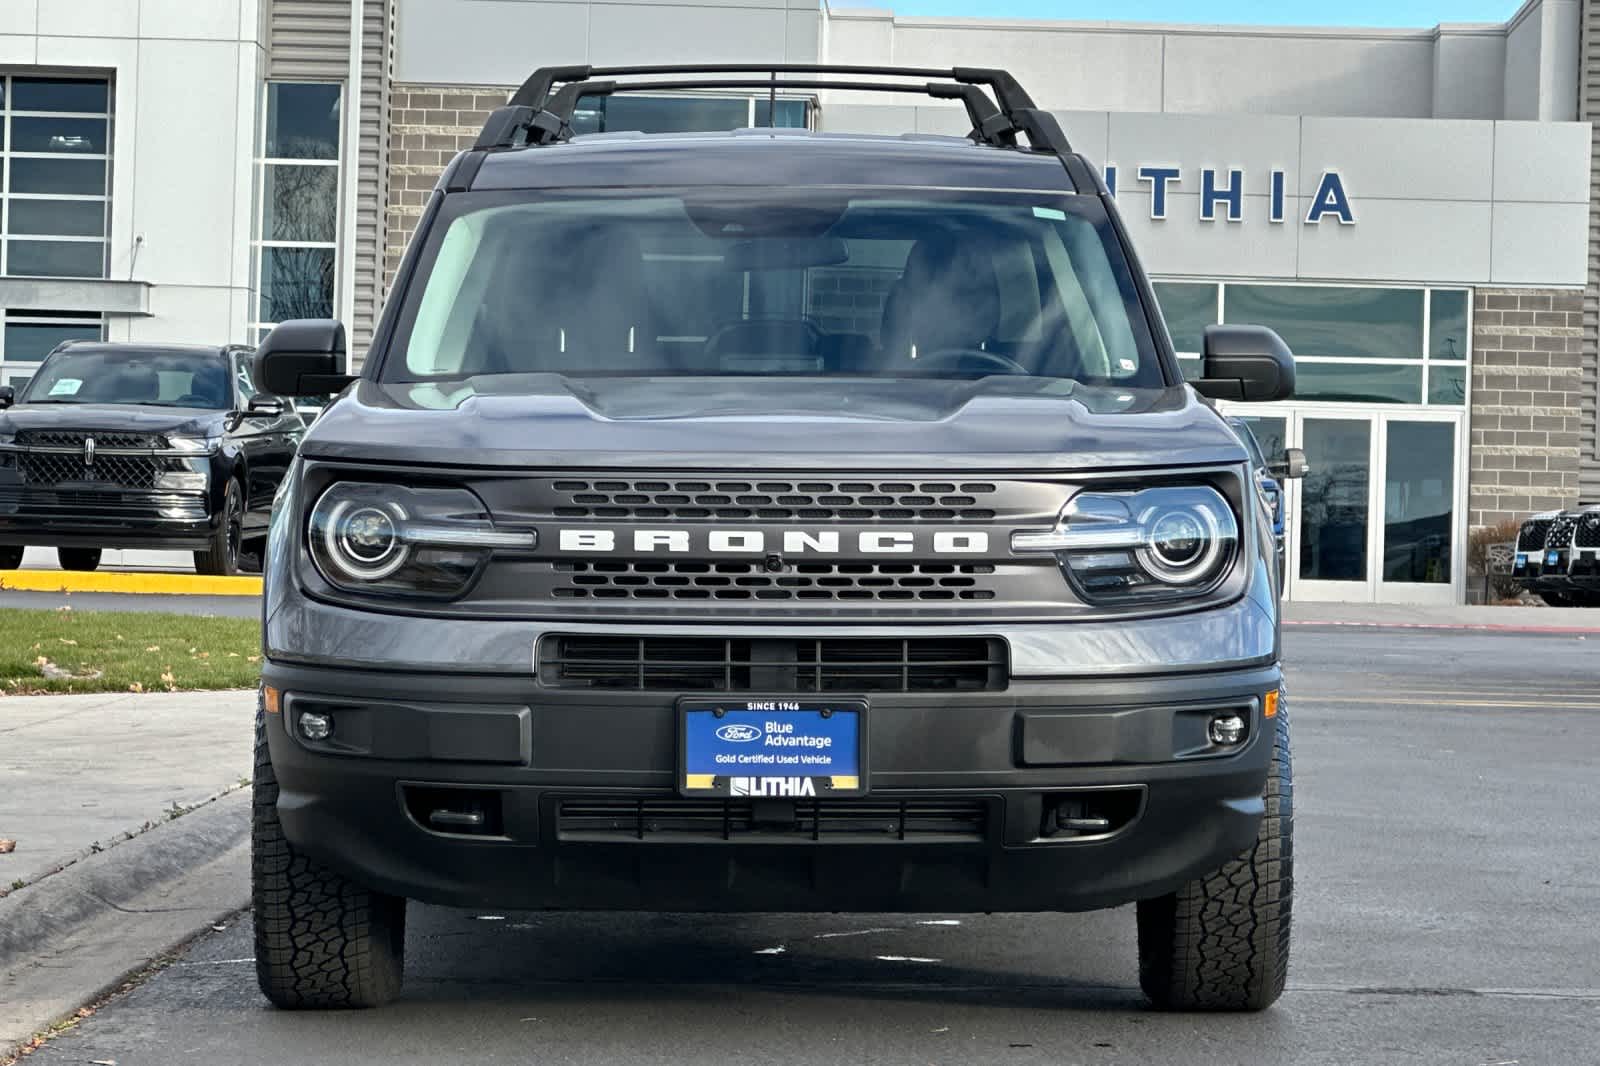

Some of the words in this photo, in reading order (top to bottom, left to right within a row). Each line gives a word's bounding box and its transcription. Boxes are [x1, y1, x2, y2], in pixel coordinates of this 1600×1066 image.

[559, 530, 989, 553] BRONCO
[747, 702, 775, 711] SINCE
[778, 702, 800, 711] 1946
[724, 727, 753, 739] Ford
[765, 722, 793, 733] Blue
[764, 735, 832, 749] Advantage
[715, 754, 736, 763] Gold
[738, 754, 774, 764] Certified
[776, 755, 799, 764] Used
[801, 755, 832, 765] Vehicle
[749, 777, 816, 796] LITHIA
